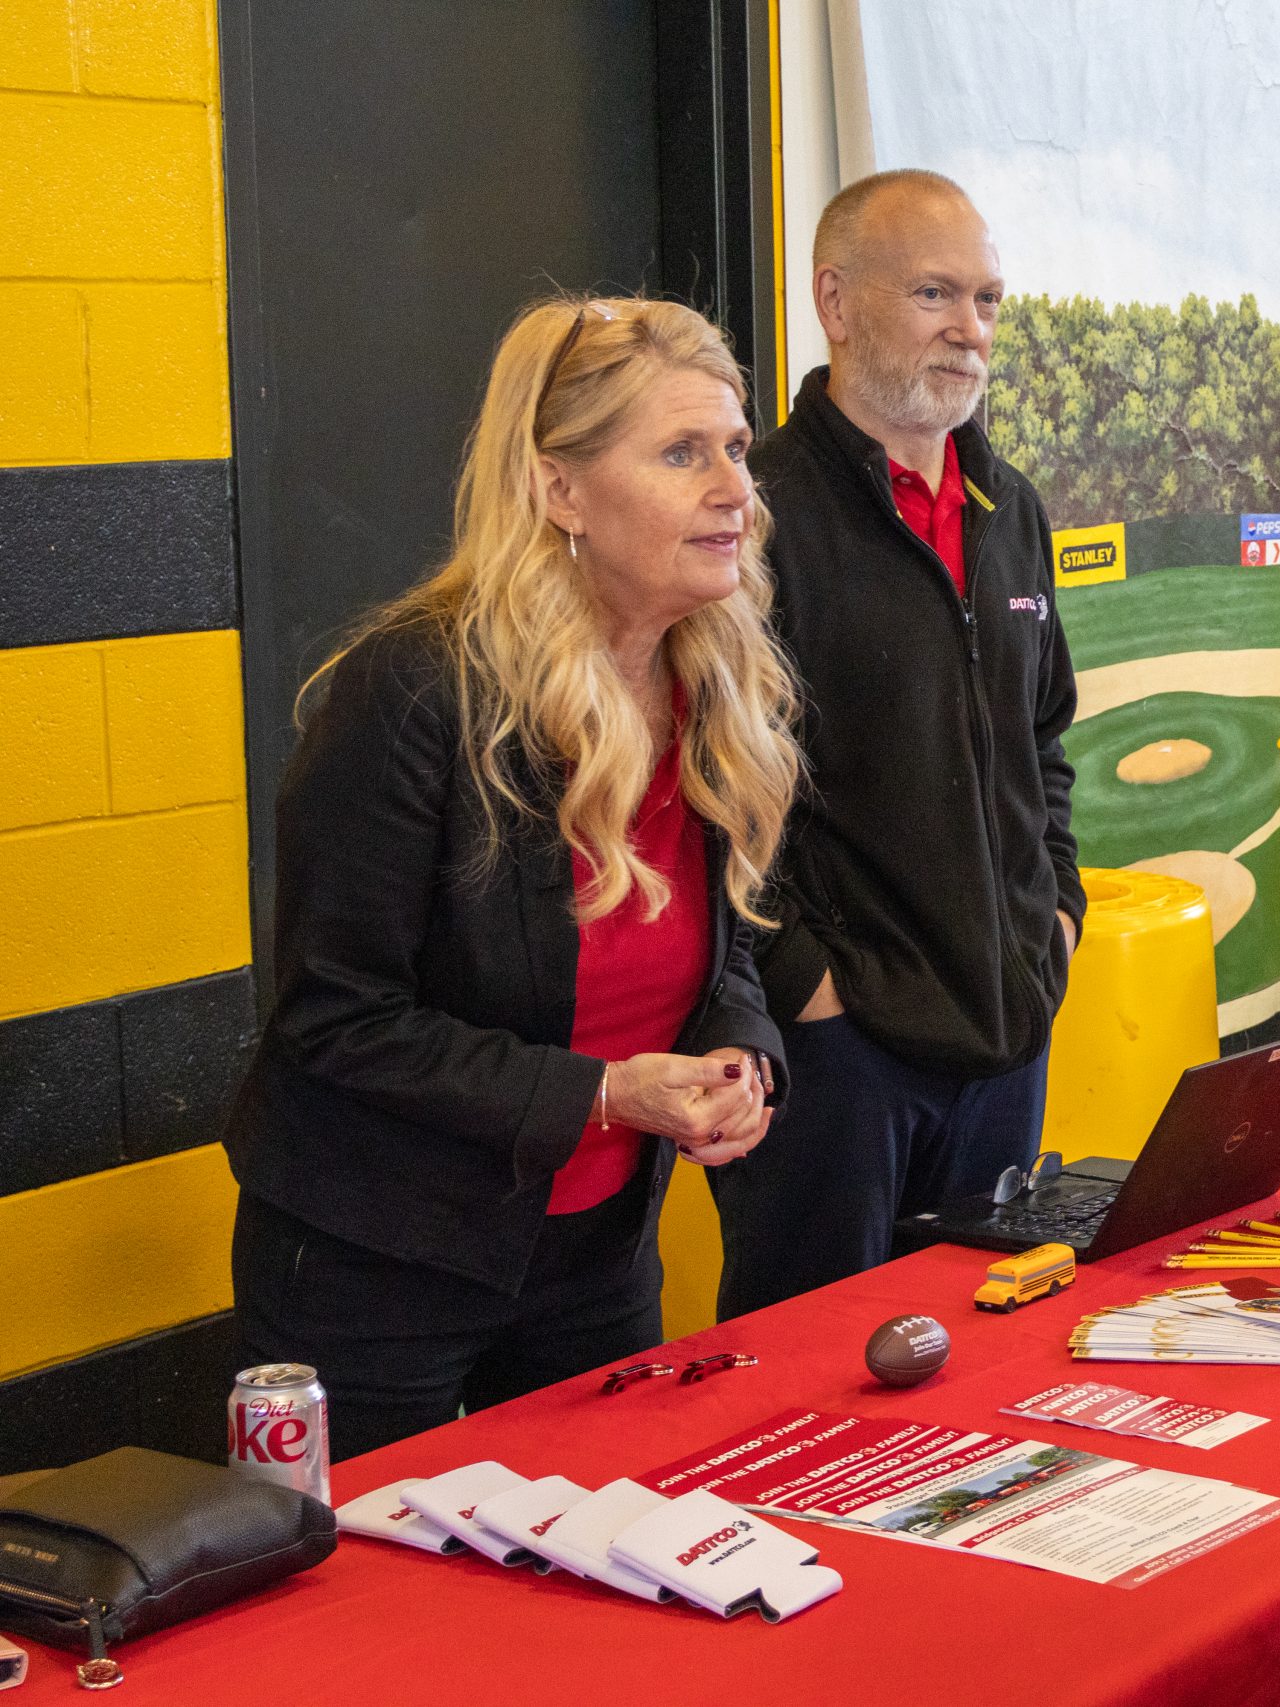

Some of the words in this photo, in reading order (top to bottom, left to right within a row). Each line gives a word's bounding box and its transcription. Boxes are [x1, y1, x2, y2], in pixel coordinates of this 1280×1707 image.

[1062, 547, 1113, 569] STANLEY
[249, 1397, 296, 1418] Diet
[1014, 1387, 1063, 1409] DATTCO
[1060, 1393, 1108, 1416] DATTCO
[1094, 1399, 1140, 1423] DATTCO
[1165, 1413, 1215, 1437] DATTCO
[656, 1473, 687, 1489] JOIN
[683, 1463, 712, 1476] THE
[706, 1440, 763, 1466] DATTCO
[774, 1412, 820, 1436] FAMILY!
[721, 1469, 750, 1481] THE
[744, 1445, 802, 1471] DATTCO
[814, 1417, 861, 1442] FAMILY!
[756, 1486, 787, 1502] JOIN
[783, 1476, 812, 1489] THE
[806, 1452, 864, 1479] DATTCO
[876, 1424, 922, 1449] FAMILY!
[794, 1492, 826, 1508] JOIN
[822, 1482, 851, 1495] THE
[845, 1458, 902, 1484] DATTCO
[913, 1430, 959, 1454] FAMILY!
[836, 1495, 869, 1512] JOIN
[866, 1485, 896, 1499] THE
[891, 1461, 952, 1489] DATTCO
[964, 1437, 1014, 1460] FAMILY!
[676, 1527, 738, 1567] DATTCO
